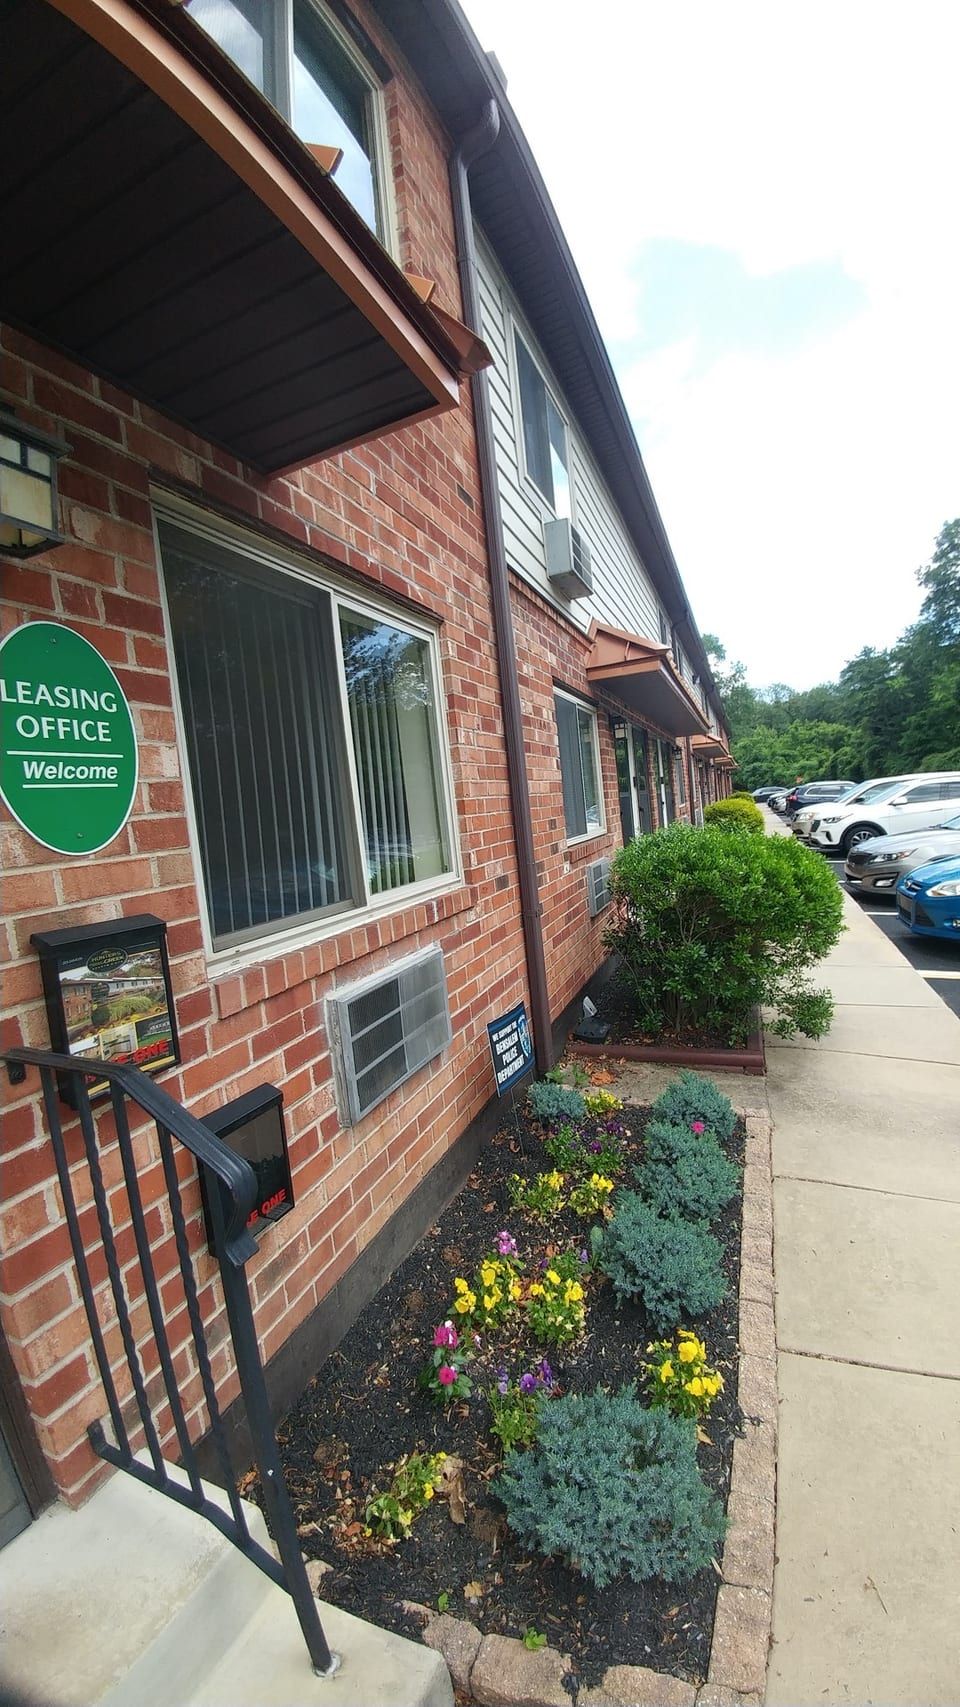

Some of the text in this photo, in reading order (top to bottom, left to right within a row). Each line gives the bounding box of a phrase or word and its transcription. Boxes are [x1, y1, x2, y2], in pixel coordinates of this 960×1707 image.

[0, 678, 118, 713] LEASING
[16, 715, 112, 742] OFFICE
[23, 761, 118, 780] Welcome
[502, 1045, 518, 1065] POLICE
[497, 1054, 525, 1084] DEPARTMENT
[261, 1188, 287, 1215] ONE
